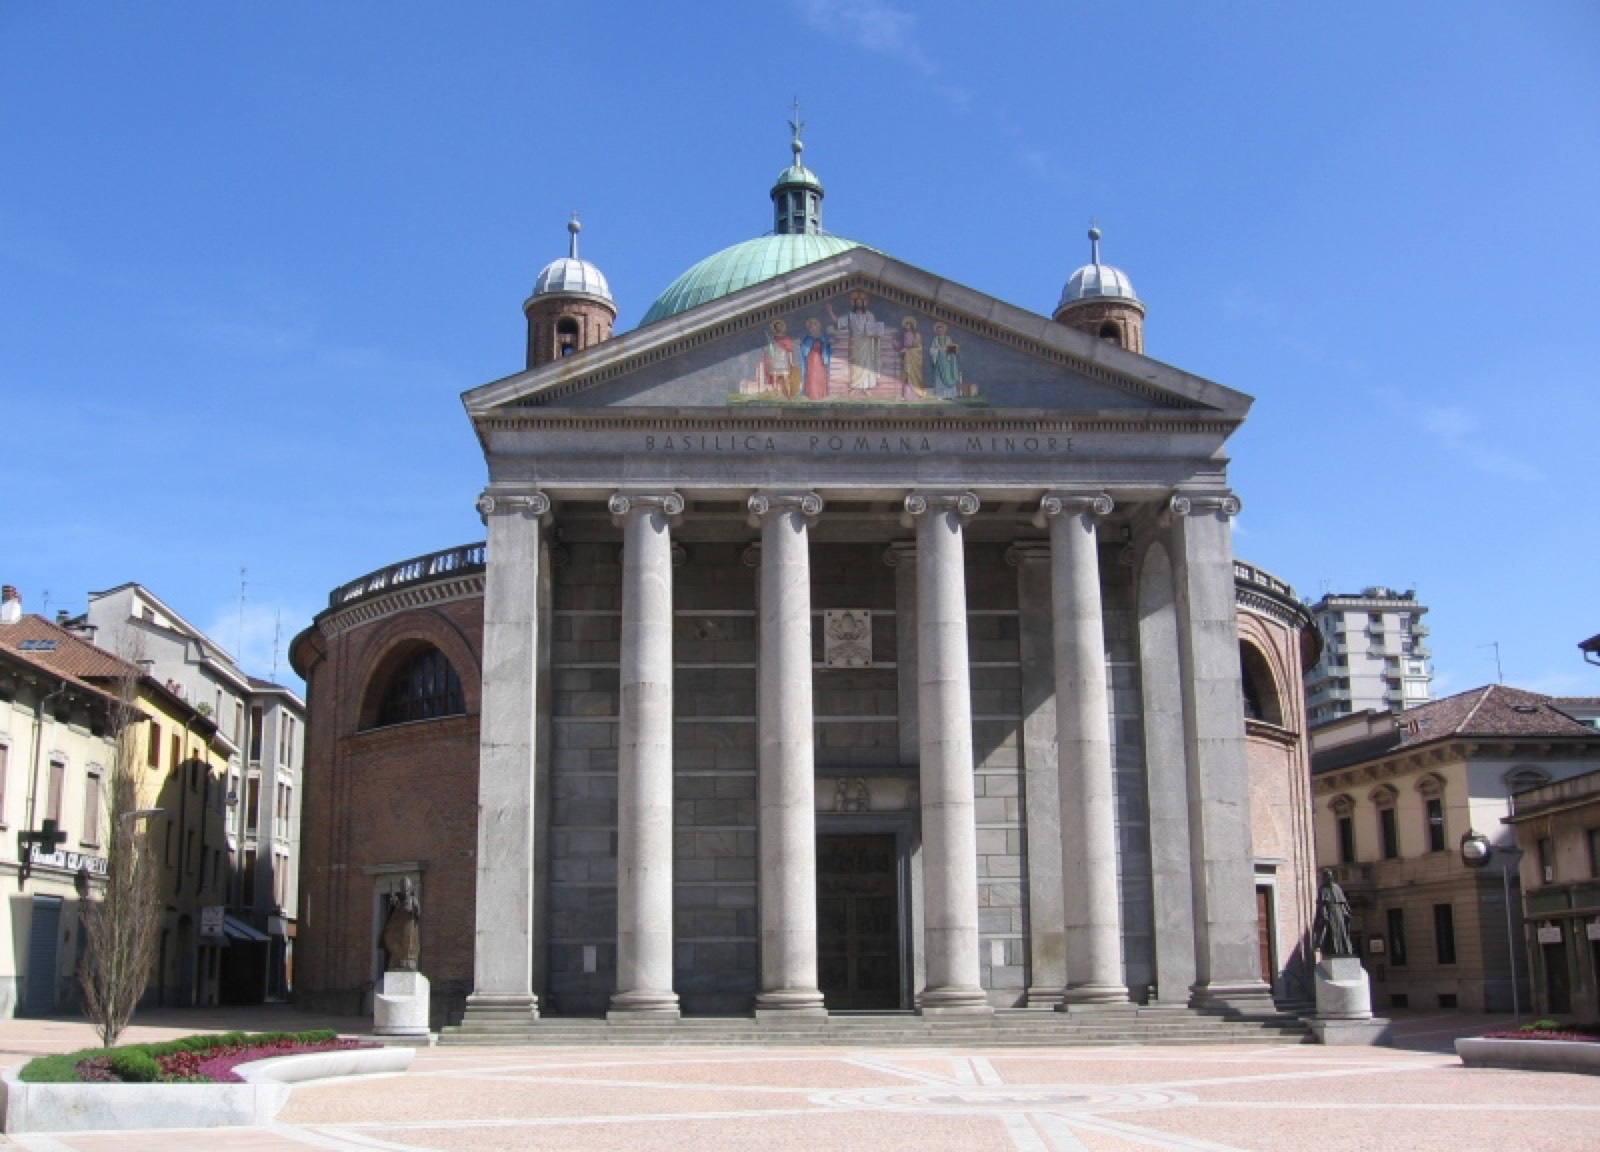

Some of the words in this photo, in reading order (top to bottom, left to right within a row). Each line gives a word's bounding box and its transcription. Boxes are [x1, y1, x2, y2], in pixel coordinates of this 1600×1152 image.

[645, 435, 775, 451] BASILICA
[809, 435, 931, 452] ROMANA
[964, 436, 1076, 453] MINORE
